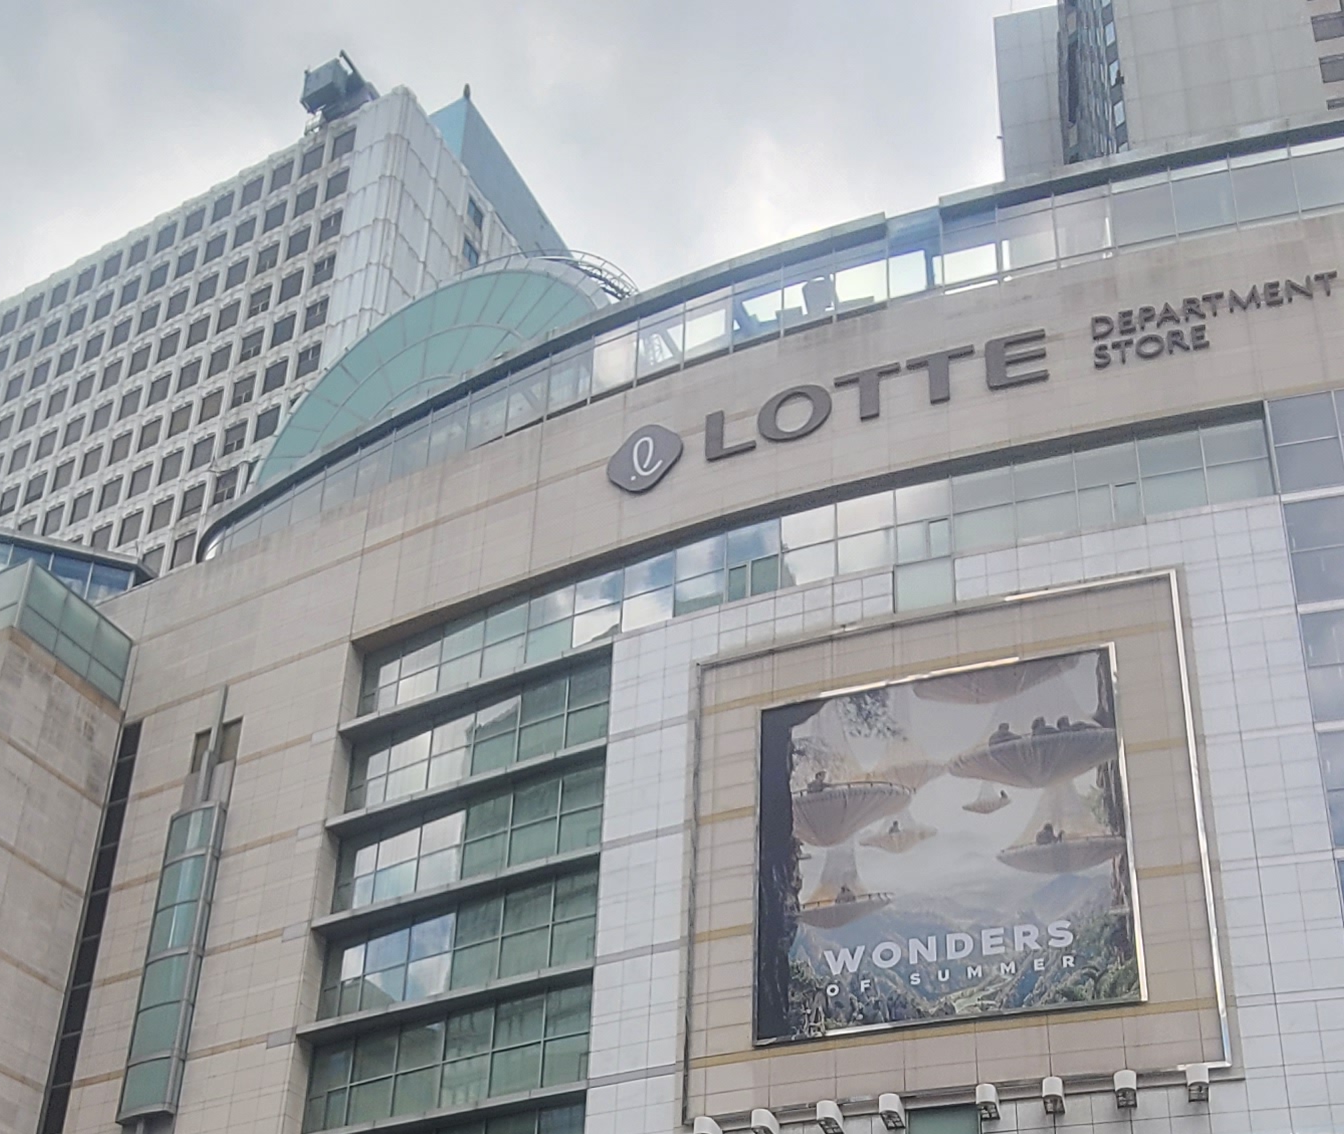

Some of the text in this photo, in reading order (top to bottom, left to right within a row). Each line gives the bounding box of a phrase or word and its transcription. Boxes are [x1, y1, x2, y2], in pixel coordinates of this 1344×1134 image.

[1090, 270, 1339, 341] DEPARTMENT
[1091, 325, 1212, 370] STORE
[704, 329, 1050, 462] LOTTE
[824, 918, 1075, 977] WONDERS
[825, 953, 1077, 997] OF SUMMER
